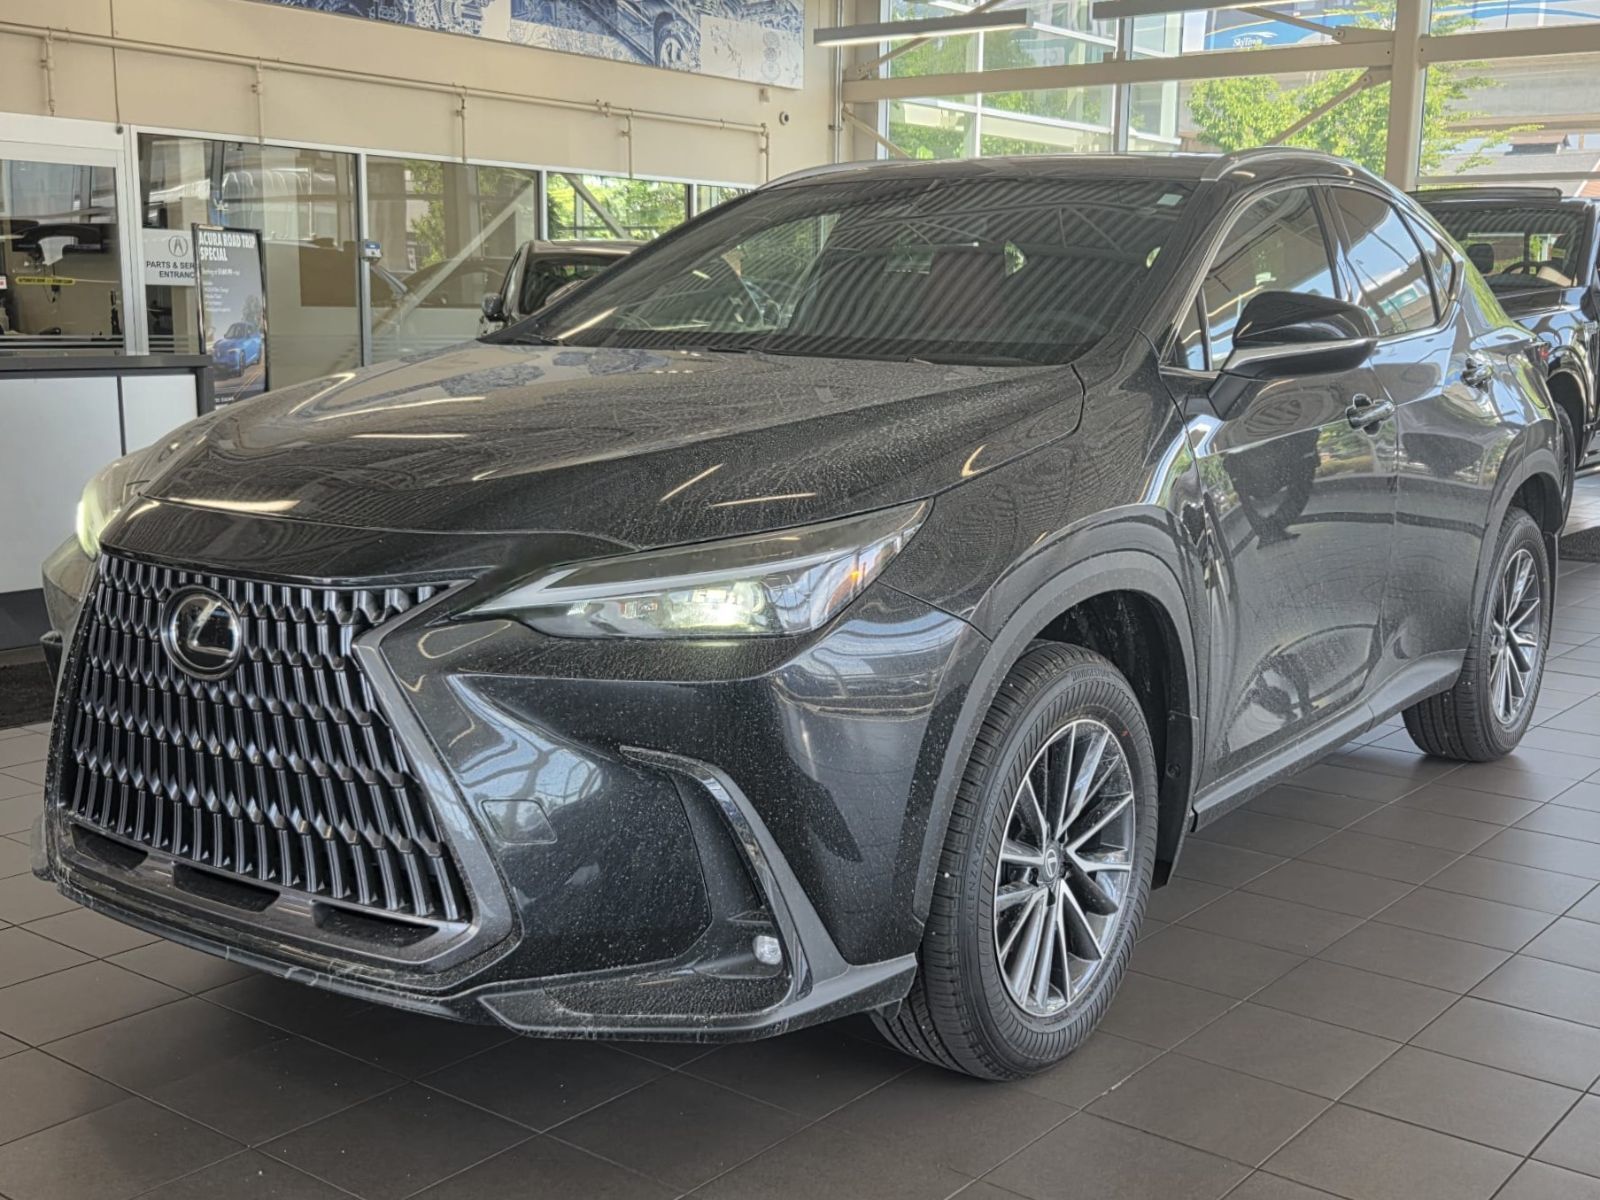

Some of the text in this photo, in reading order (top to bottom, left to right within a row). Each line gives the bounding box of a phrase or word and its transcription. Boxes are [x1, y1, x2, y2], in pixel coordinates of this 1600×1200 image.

[199, 232, 256, 249] ACURA ROAD TRIP
[200, 246, 228, 261] SPECIAL
[146, 261, 171, 269] PARTS
[159, 270, 195, 279] ENTRANC
